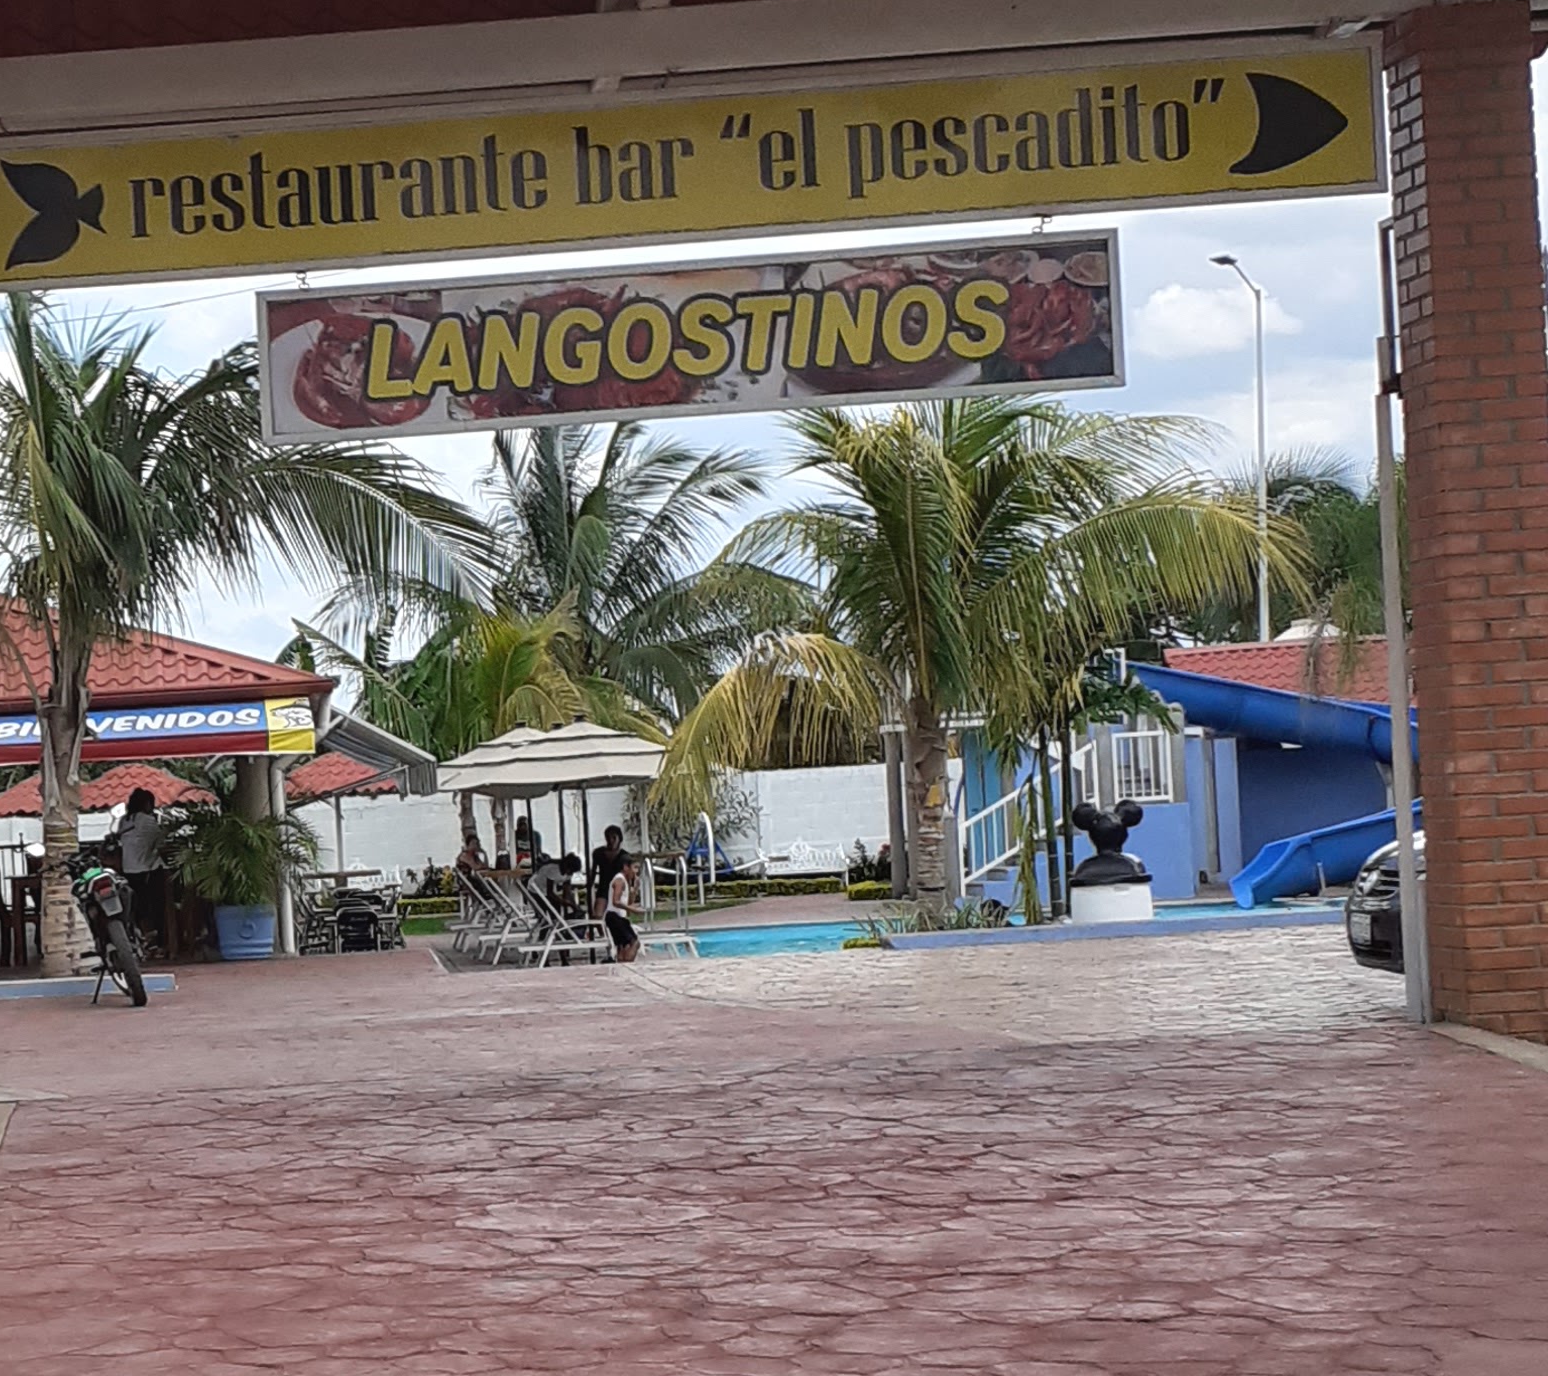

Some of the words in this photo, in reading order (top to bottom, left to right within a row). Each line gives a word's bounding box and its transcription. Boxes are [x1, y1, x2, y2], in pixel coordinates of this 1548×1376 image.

[129, 133, 549, 238] restaurante
[571, 125, 694, 205] bar
[364, 278, 1013, 402] LANGOSTINOS
